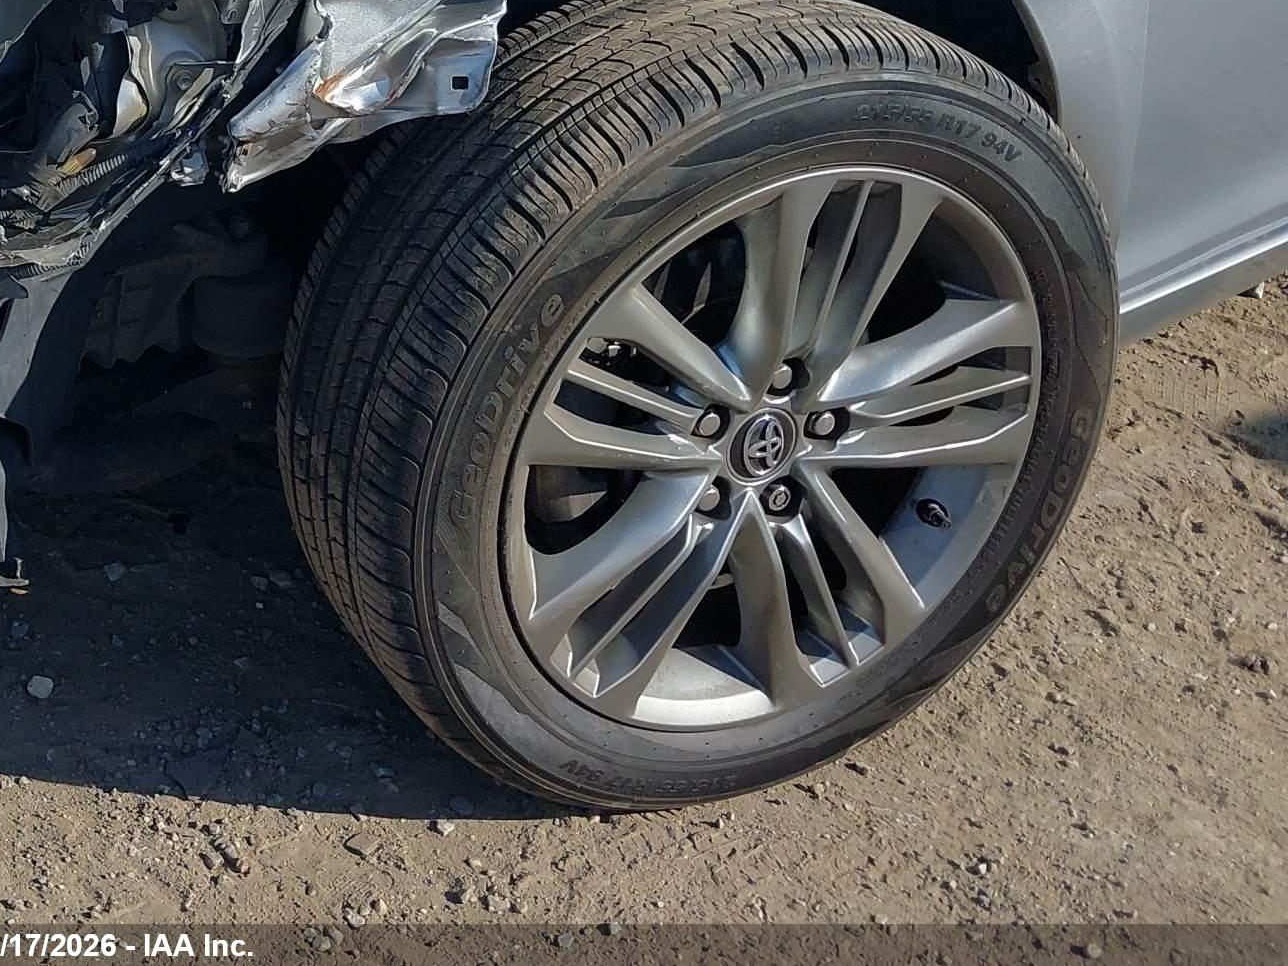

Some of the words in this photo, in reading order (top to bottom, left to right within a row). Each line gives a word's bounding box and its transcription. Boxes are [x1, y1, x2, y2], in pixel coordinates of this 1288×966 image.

[937, 113, 980, 139] R17
[980, 131, 1022, 164] 94V
[449, 291, 565, 524] GeoDrive
[983, 410, 1092, 617] GeoDrive
